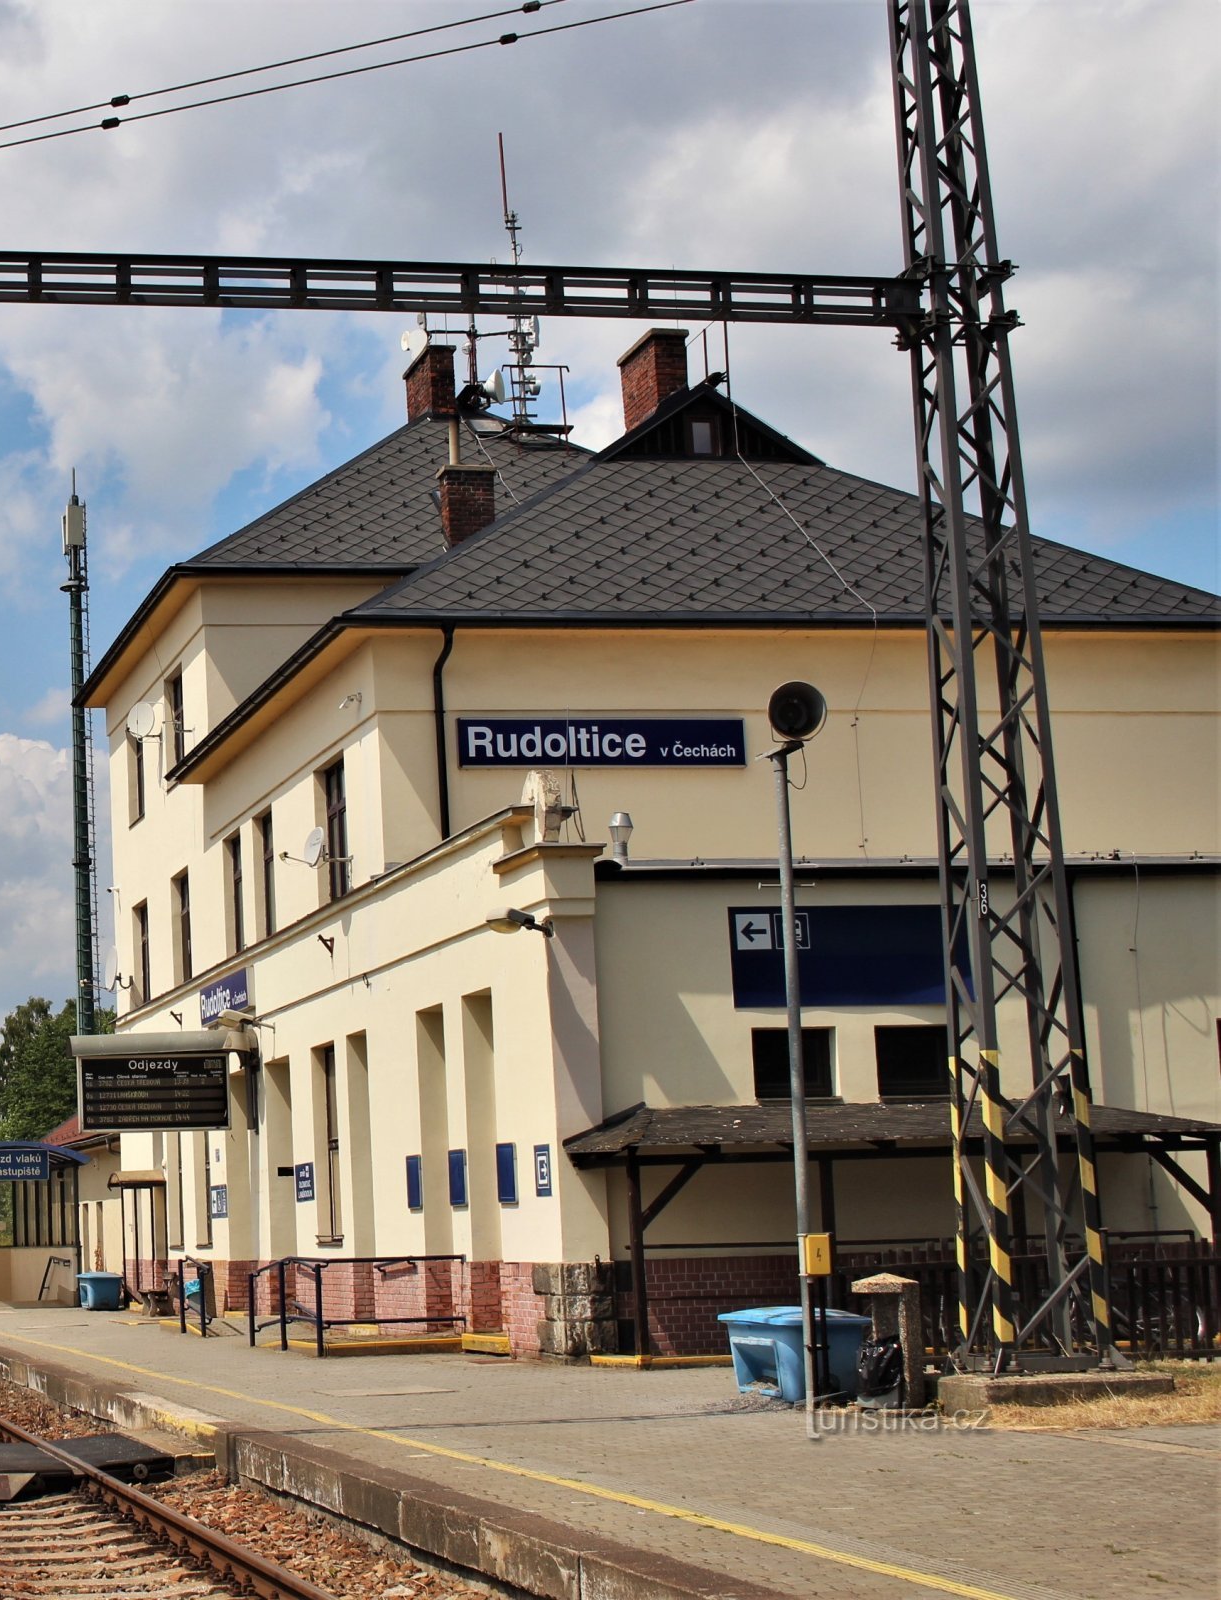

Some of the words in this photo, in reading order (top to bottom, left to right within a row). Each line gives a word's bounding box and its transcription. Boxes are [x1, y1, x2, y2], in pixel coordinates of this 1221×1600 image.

[467, 726, 646, 758] Rudoltice
[660, 747, 669, 758] v
[672, 740, 736, 758] Čechách
[980, 883, 988, 915] 36
[201, 985, 231, 1019] Rudoltice
[128, 1060, 179, 1072] Odjezdy
[15, 1153, 41, 1163] vlaků
